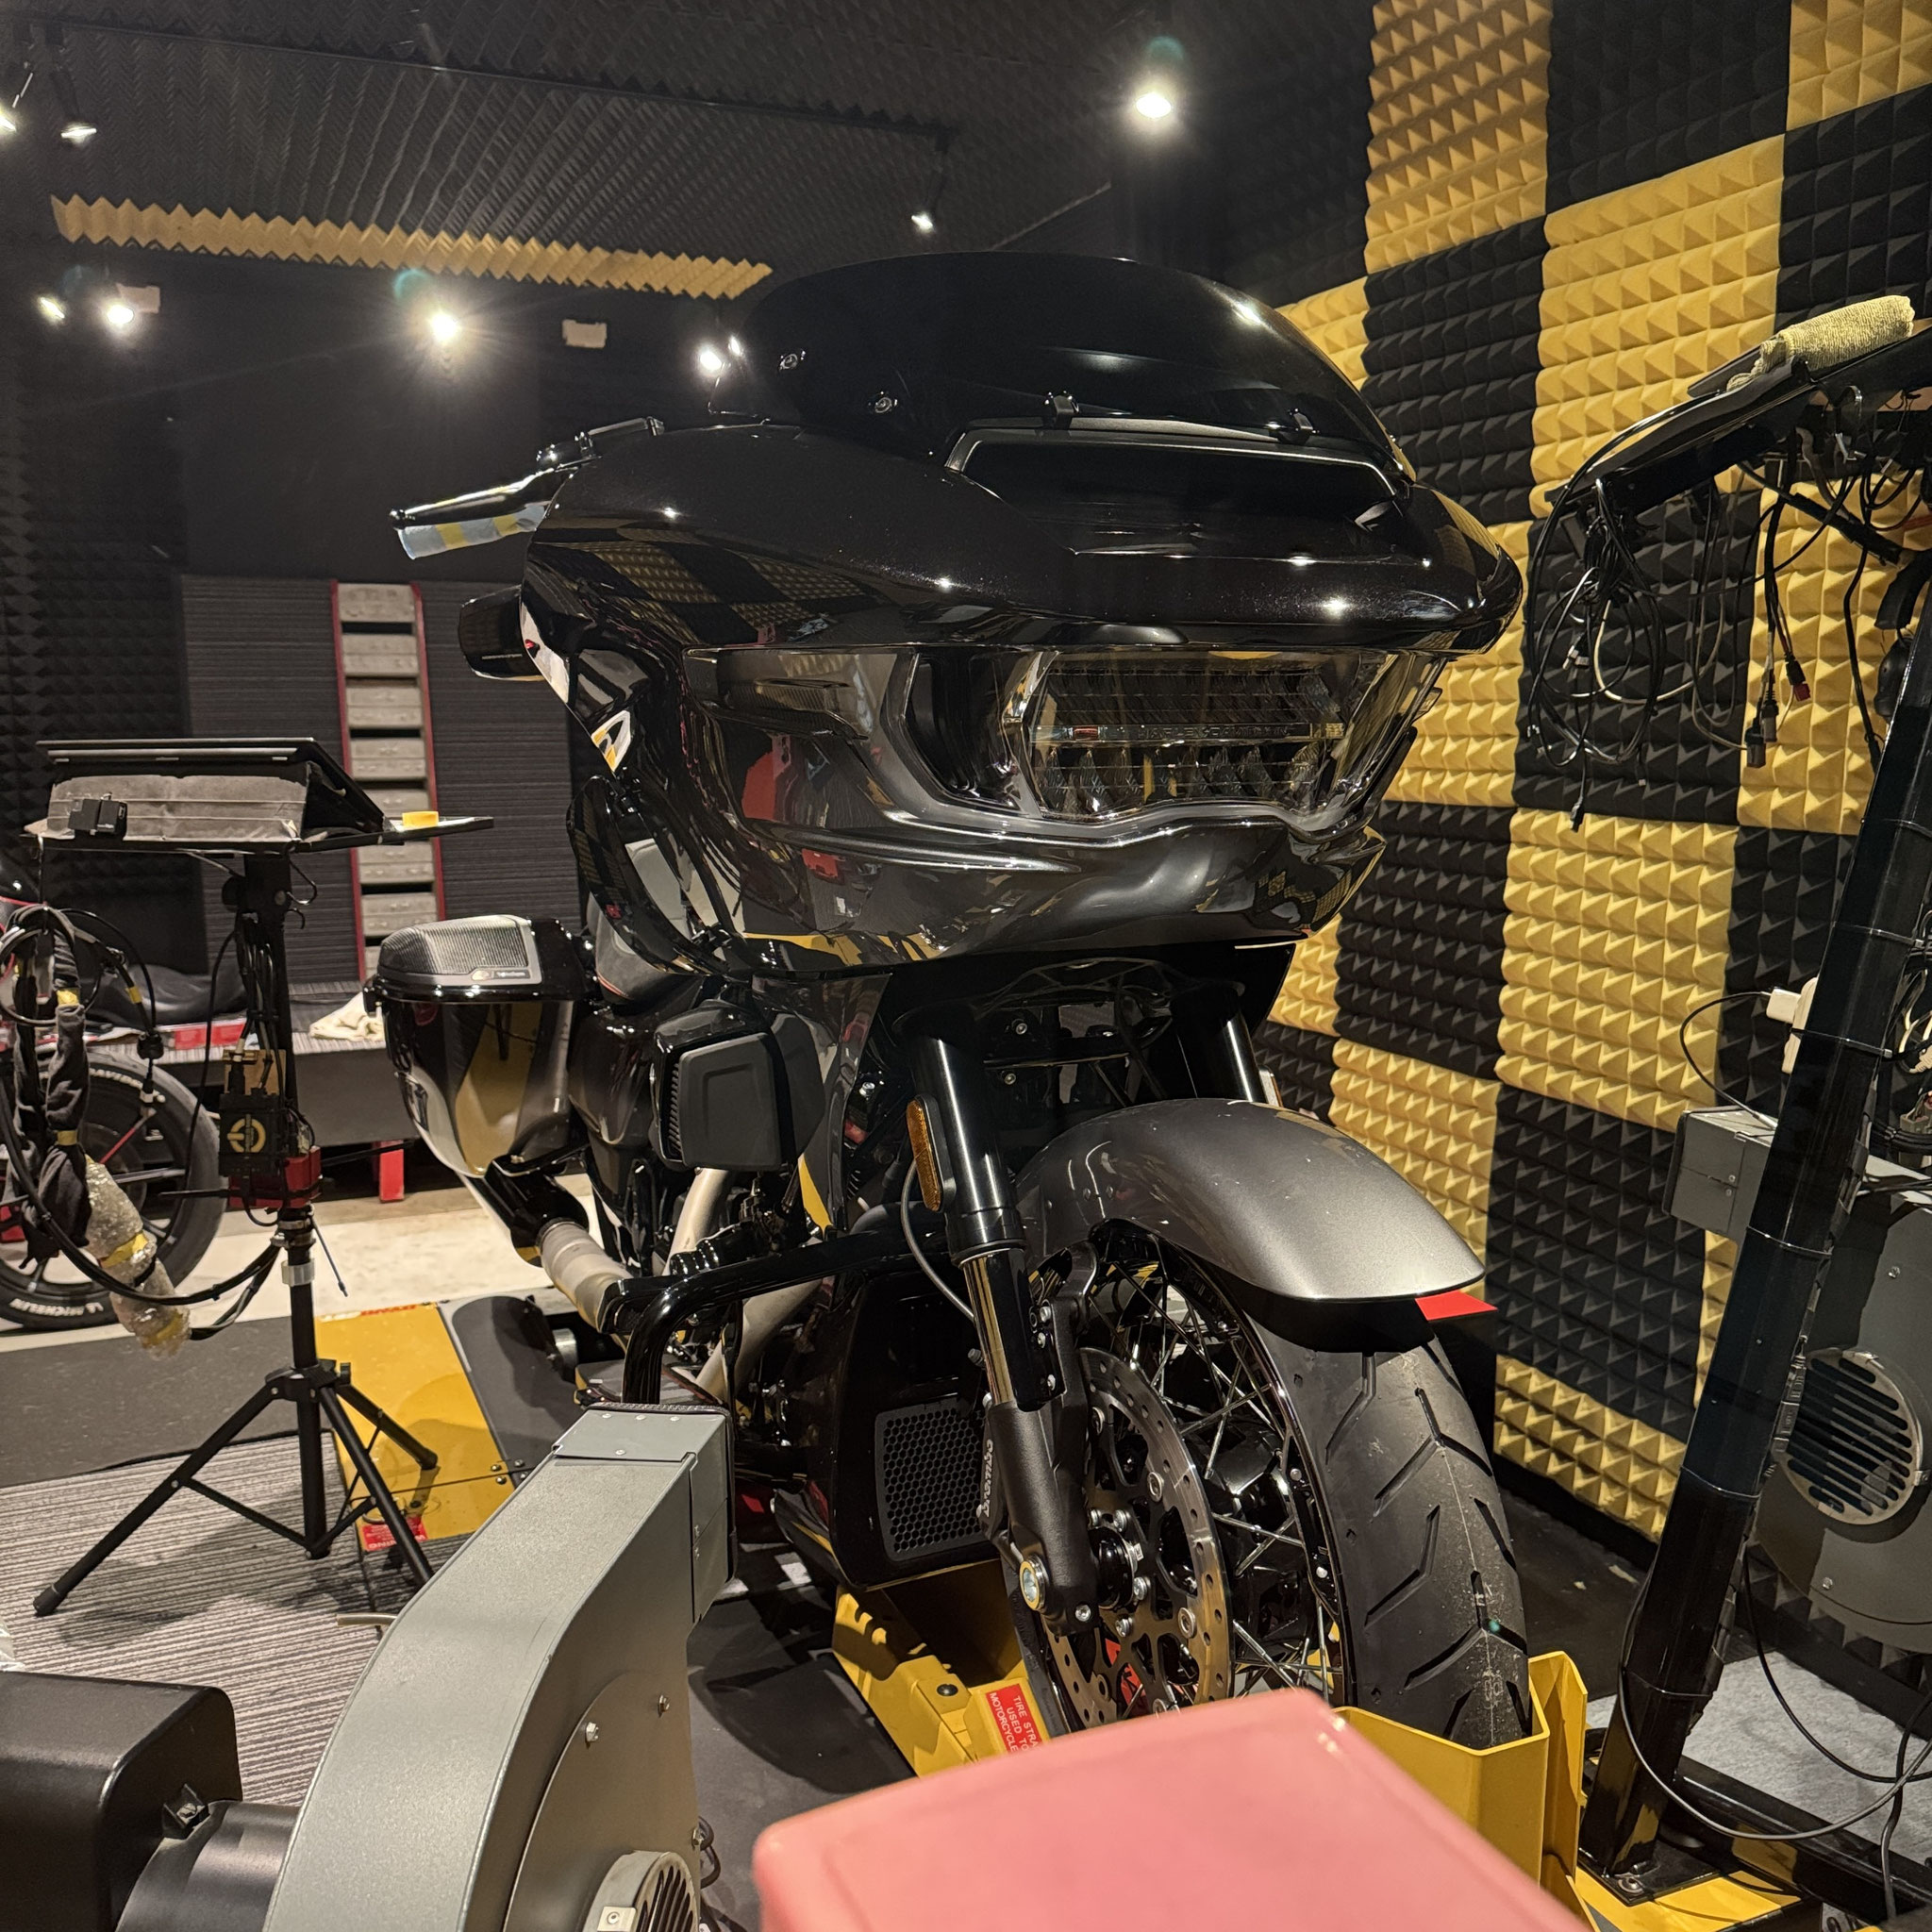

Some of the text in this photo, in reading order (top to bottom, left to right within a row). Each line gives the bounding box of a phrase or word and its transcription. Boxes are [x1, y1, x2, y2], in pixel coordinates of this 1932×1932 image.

[990, 1692, 1020, 1753] MOTORCYCLE
[1007, 1707, 1030, 1752] USED TO
[1013, 1694, 1039, 1747] TIRE STRA
